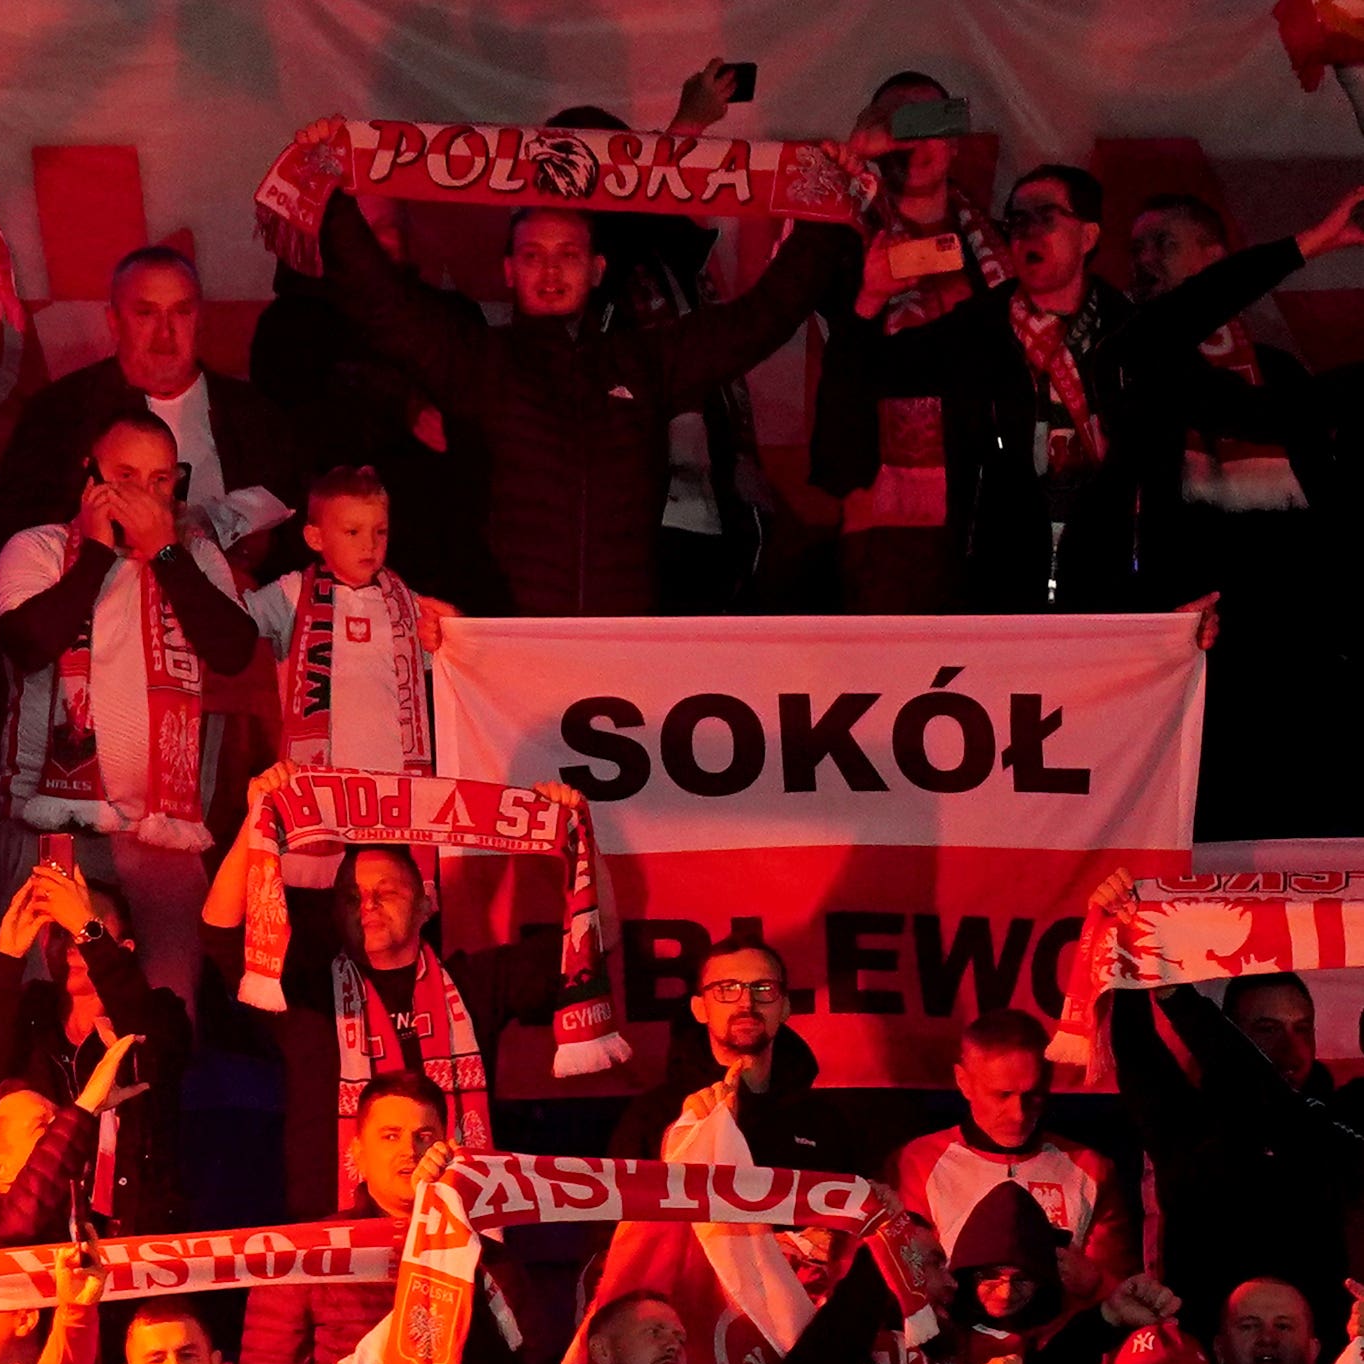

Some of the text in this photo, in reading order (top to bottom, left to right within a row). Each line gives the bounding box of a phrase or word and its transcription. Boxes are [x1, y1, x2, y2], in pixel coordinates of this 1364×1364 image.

[370, 122, 752, 202] POL SKA
[558, 667, 1091, 801] SOKÓŁ
[277, 774, 410, 829] POLA
[429, 779, 474, 827] V
